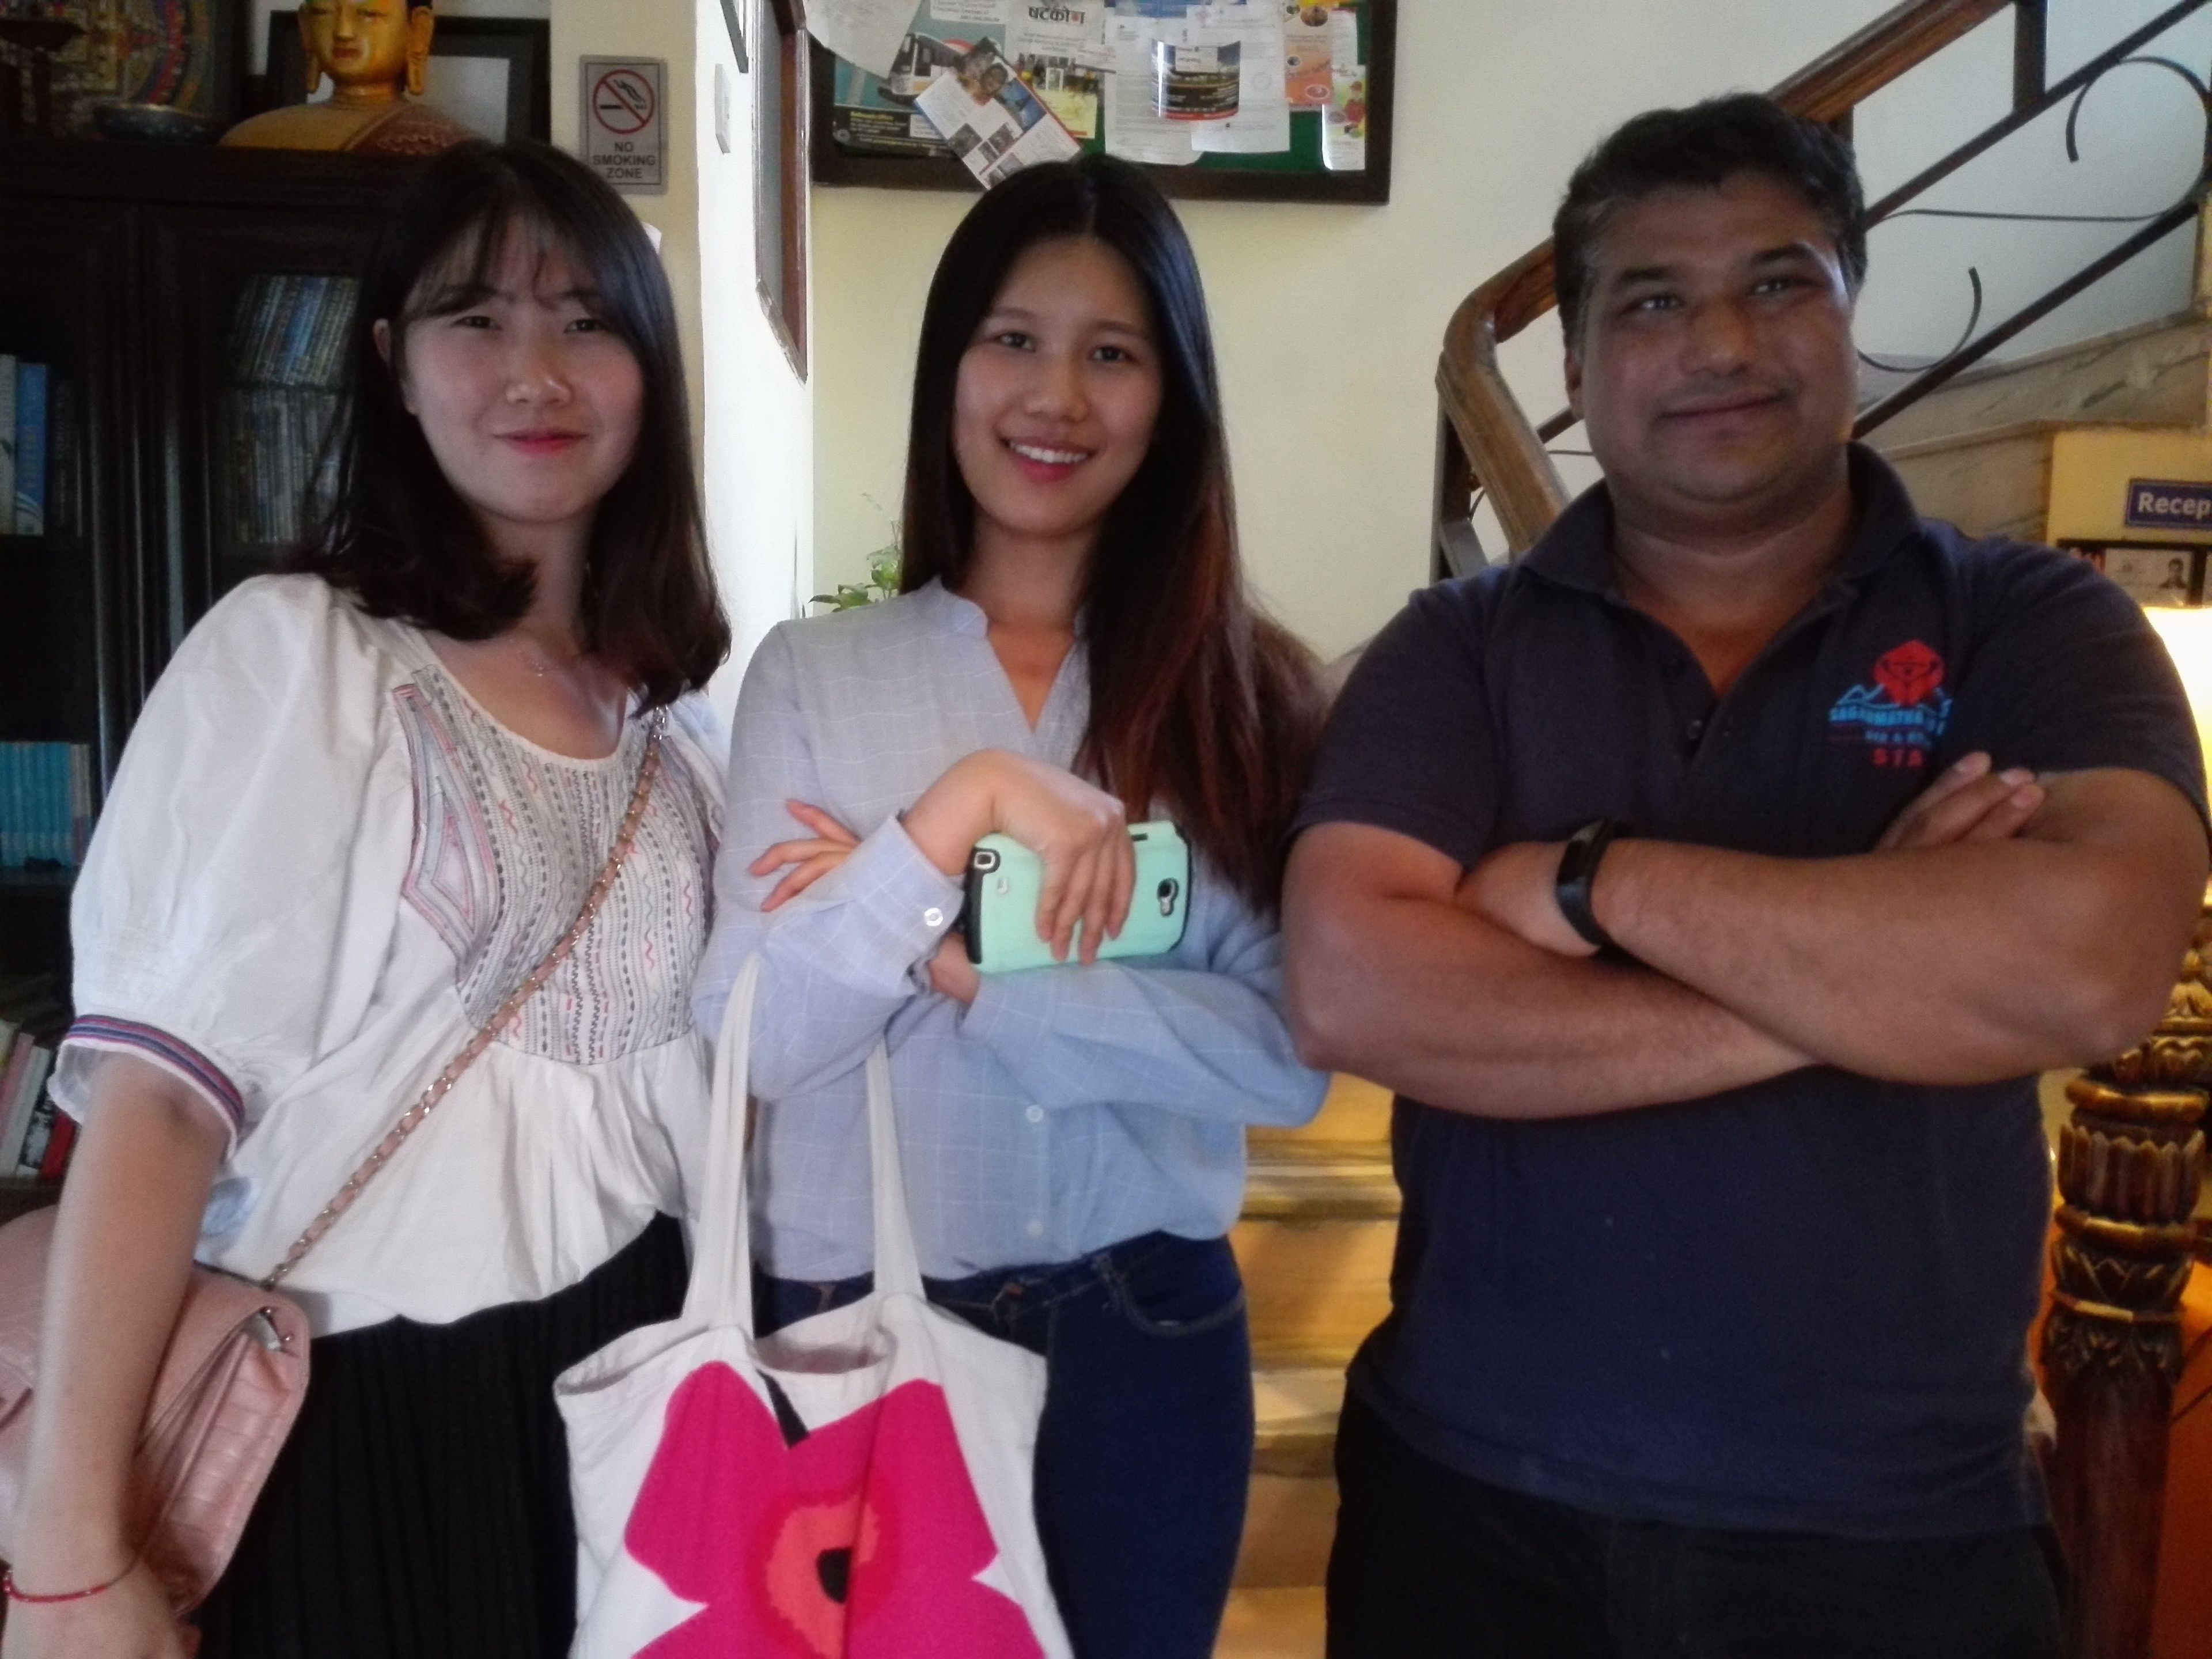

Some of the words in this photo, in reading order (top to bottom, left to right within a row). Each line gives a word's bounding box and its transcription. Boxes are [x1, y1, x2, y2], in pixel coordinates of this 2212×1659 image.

[615, 142, 634, 153] NO
[593, 155, 656, 166] SMOKING
[606, 168, 642, 179] ZONE
